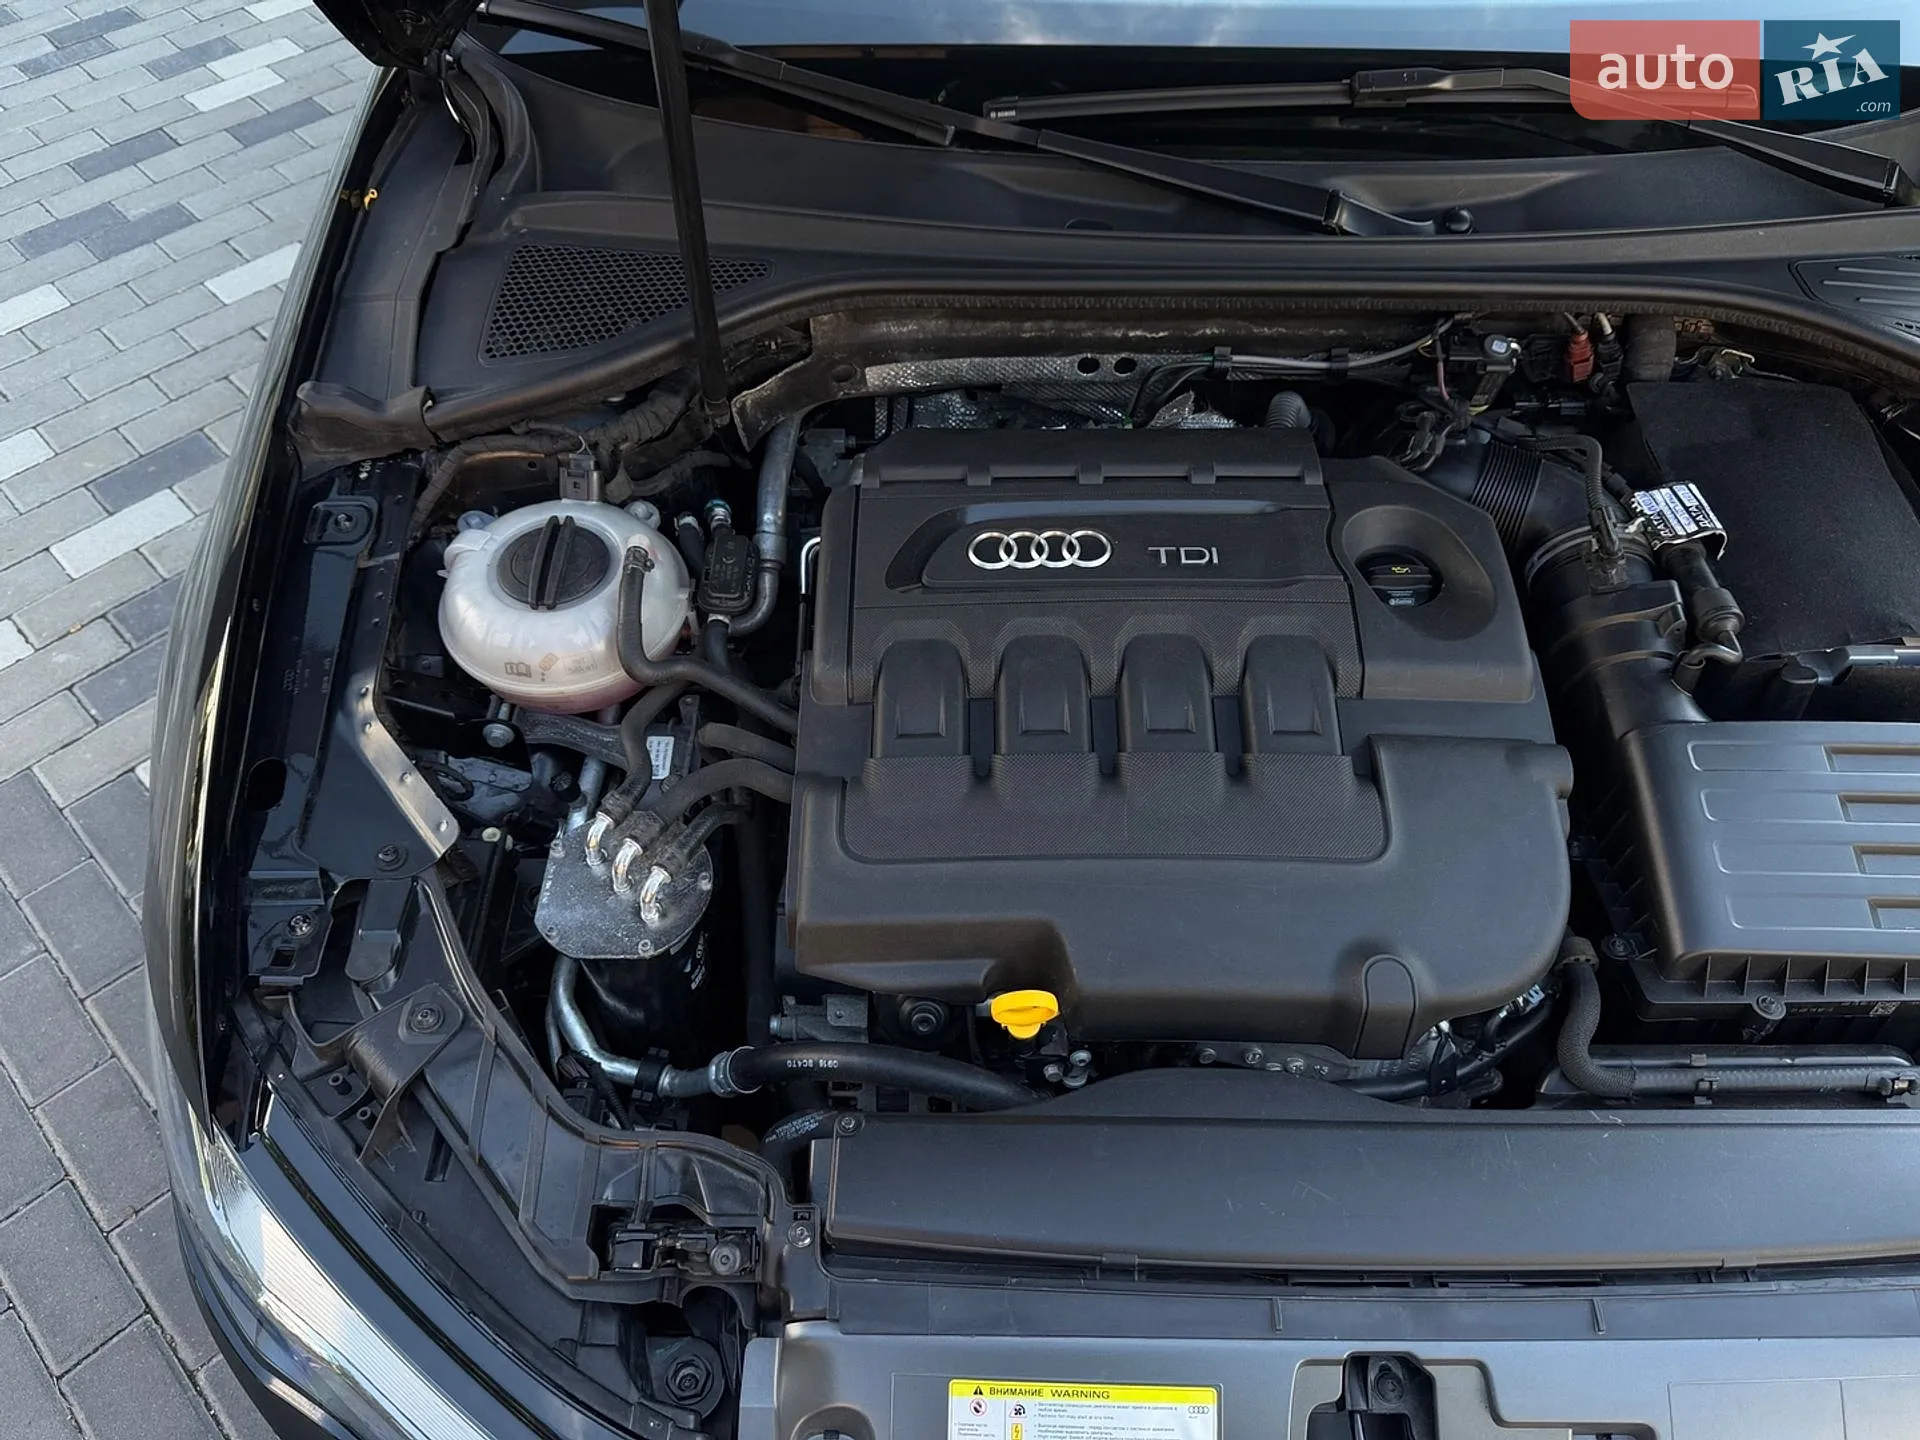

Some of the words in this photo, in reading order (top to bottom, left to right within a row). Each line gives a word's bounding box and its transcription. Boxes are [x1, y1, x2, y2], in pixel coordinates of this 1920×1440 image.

[1147, 546, 1219, 565] TDI
[989, 1386, 1044, 1397] ВНИМАНИЕ
[1050, 1388, 1111, 1399] WARNING
